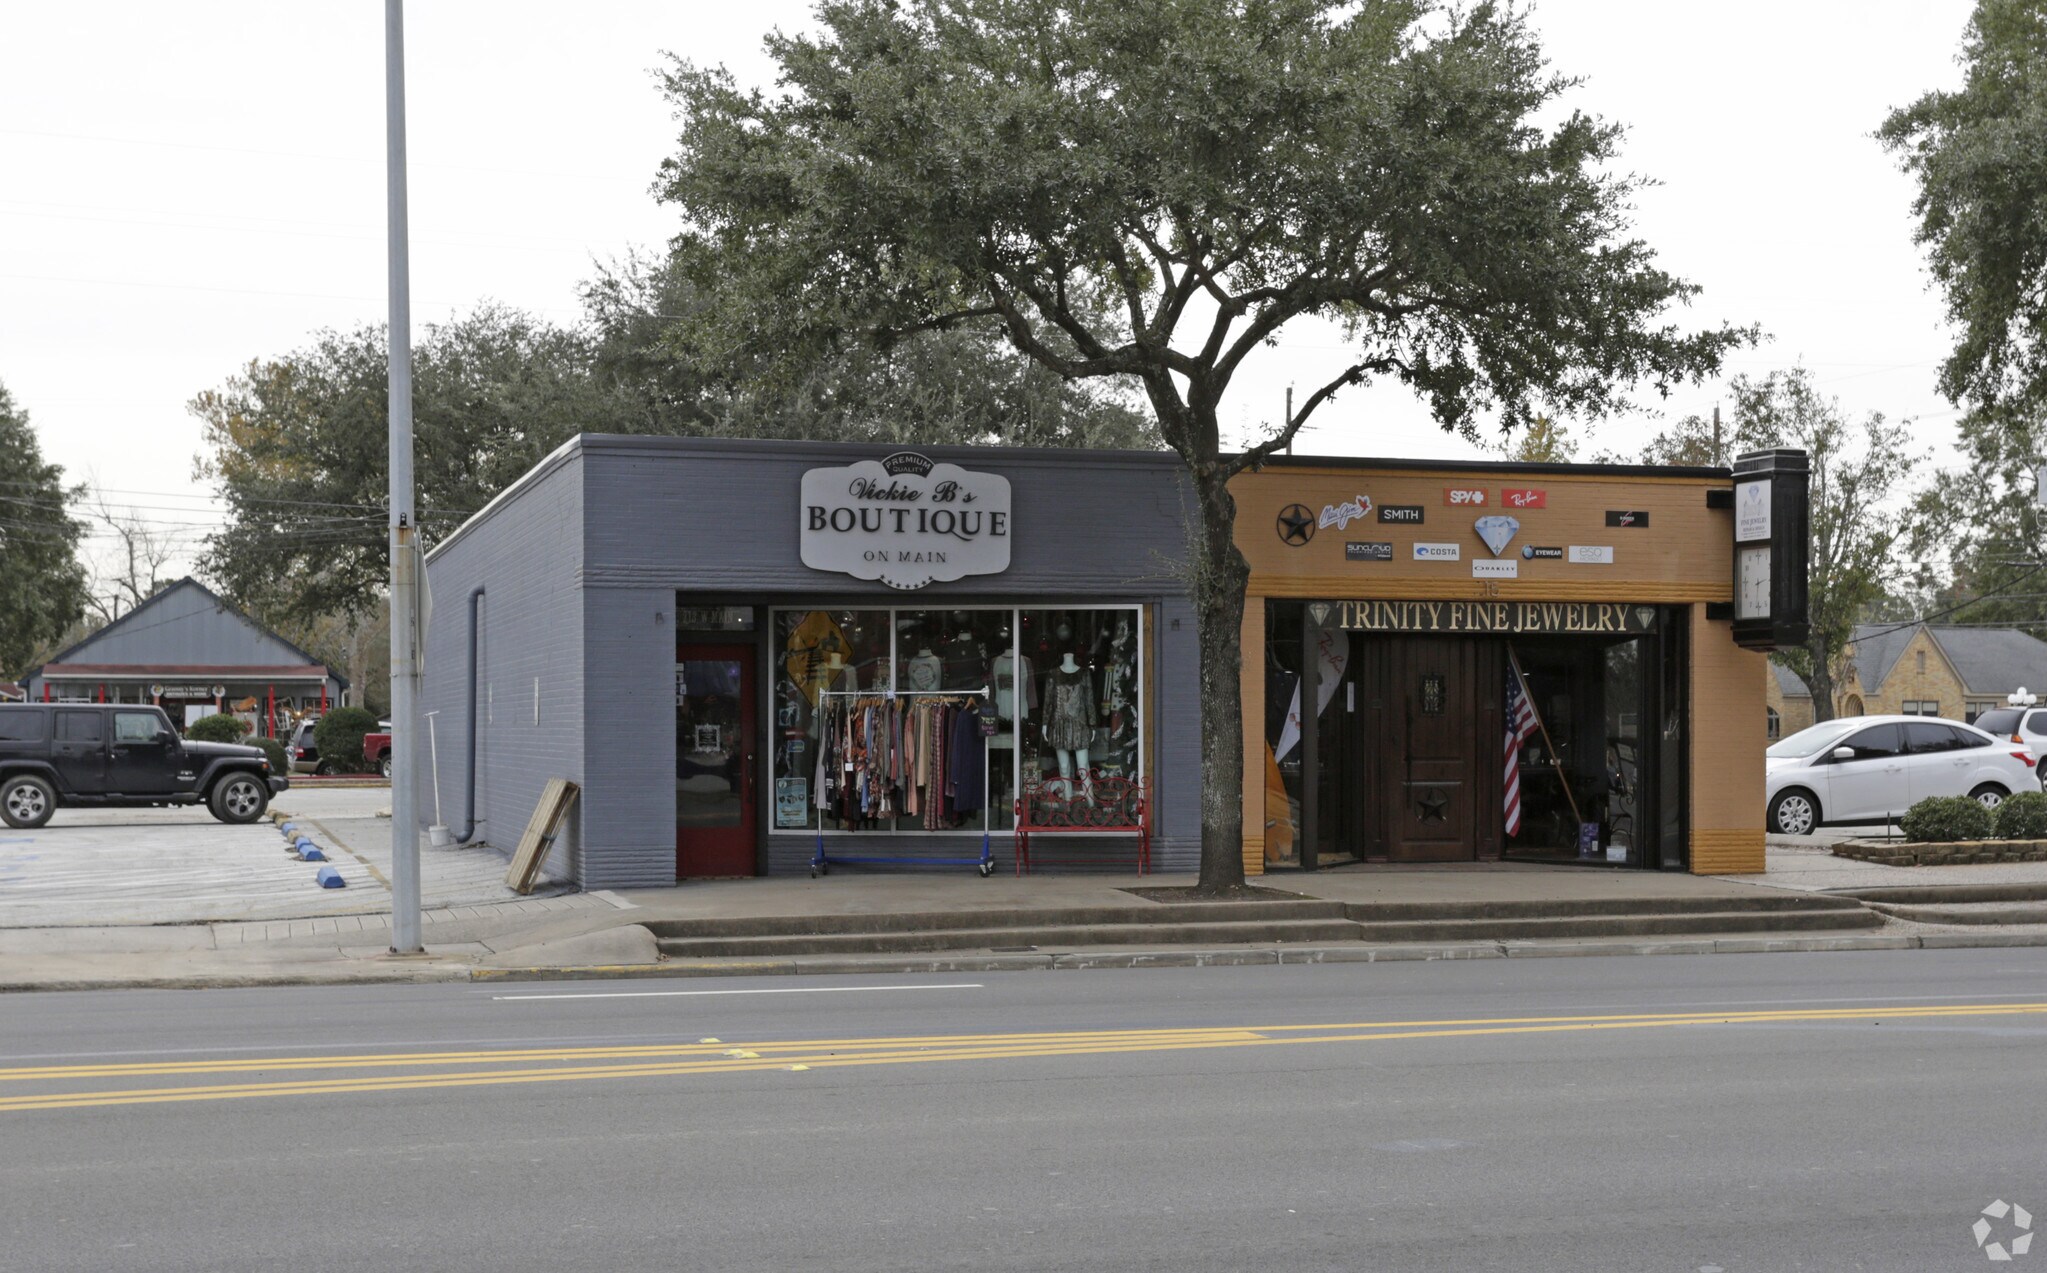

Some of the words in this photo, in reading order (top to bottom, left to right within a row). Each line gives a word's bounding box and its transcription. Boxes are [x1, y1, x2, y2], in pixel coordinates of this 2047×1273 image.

[885, 455, 931, 470] PREMIUM
[848, 477, 924, 502] Vickie
[1383, 509, 1419, 520] SMITH
[807, 505, 1007, 542] BOUTIQUE
[863, 550, 889, 562] ON
[899, 550, 947, 563] MAIN
[1430, 548, 1457, 556] COSTA
[1336, 600, 1443, 629] TRINITY
[1449, 601, 1510, 631] FINE
[1514, 602, 1631, 633] JEWELRY
